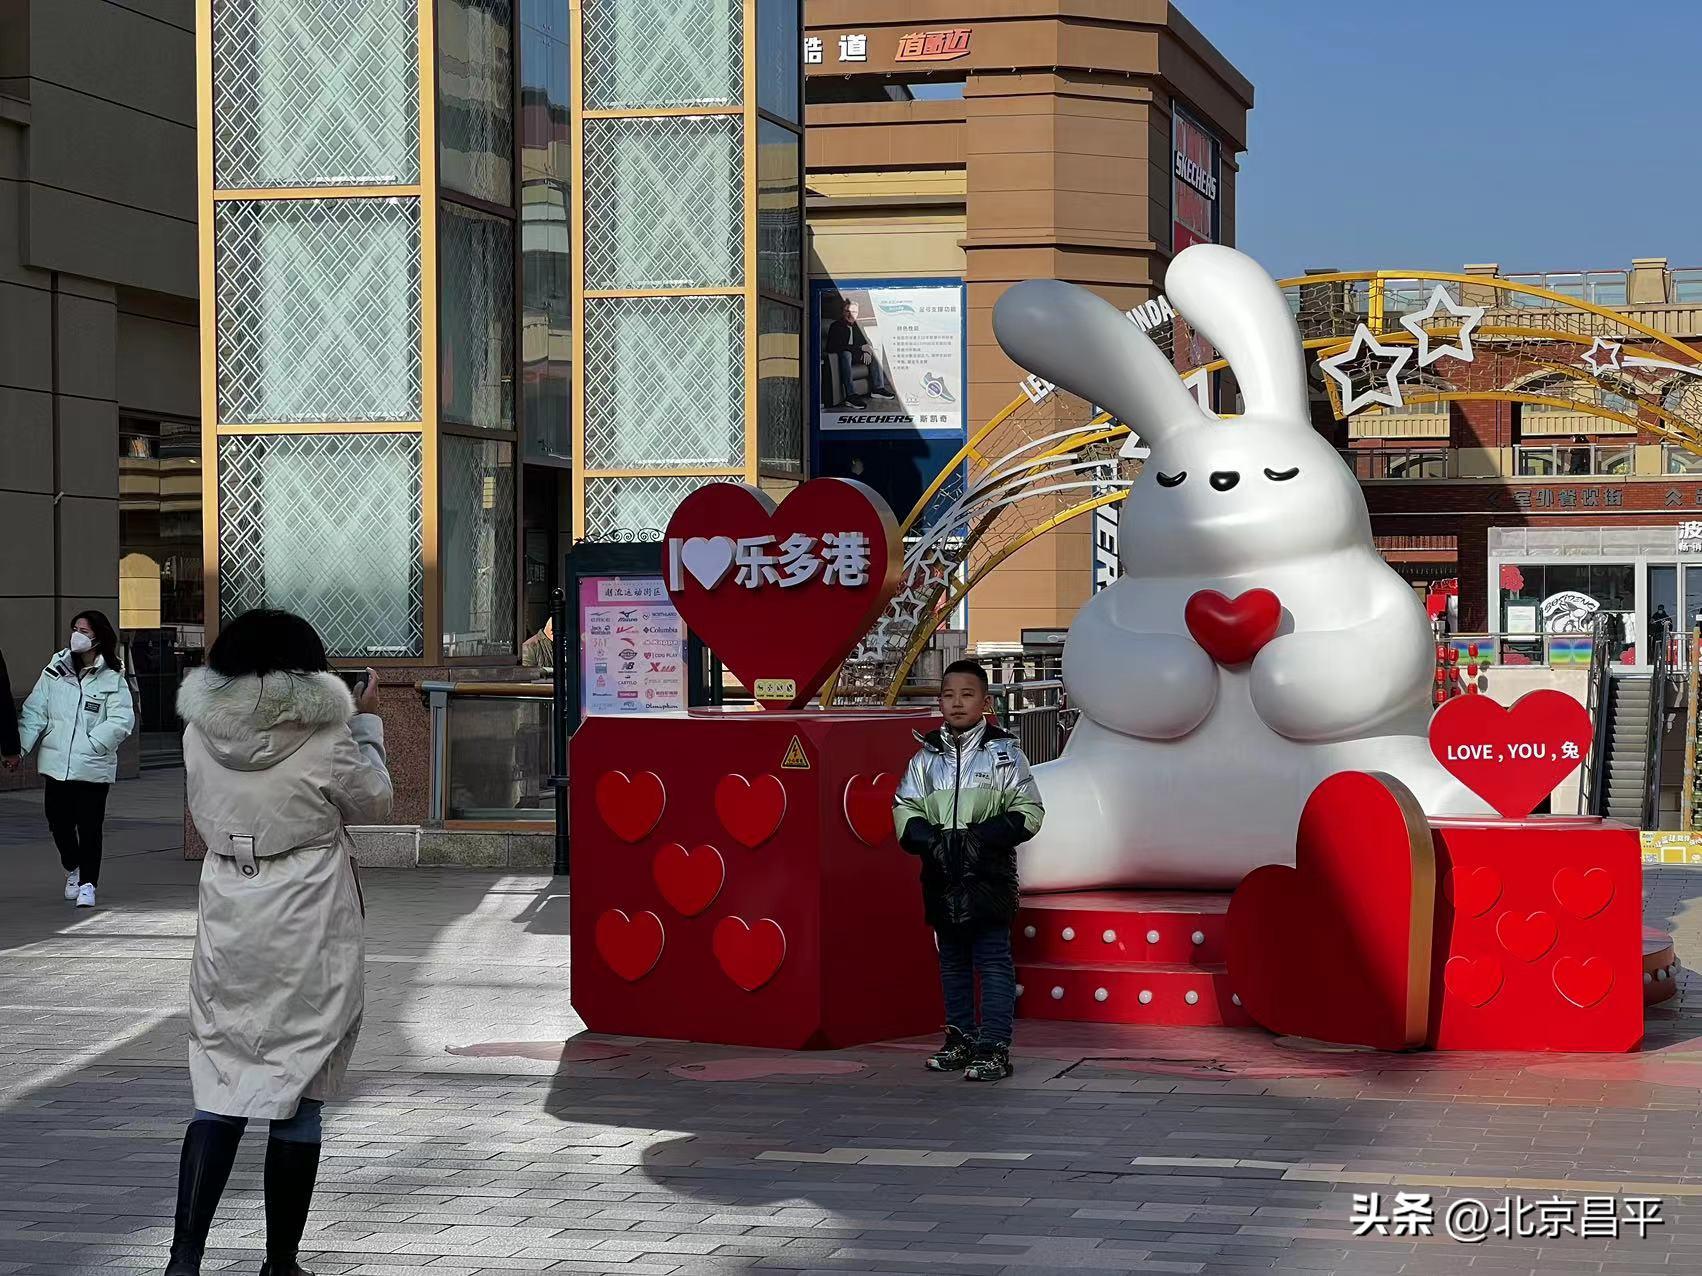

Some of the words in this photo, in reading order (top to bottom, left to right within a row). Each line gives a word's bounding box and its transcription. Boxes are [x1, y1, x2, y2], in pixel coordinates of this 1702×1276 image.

[1175, 150, 1217, 200] SKECHERS
[837, 415, 914, 424] SKECHERS
[919, 415, 948, 423] 斯凯奇
[734, 531, 871, 588] 乐多港
[1561, 741, 1580, 759] 兔
